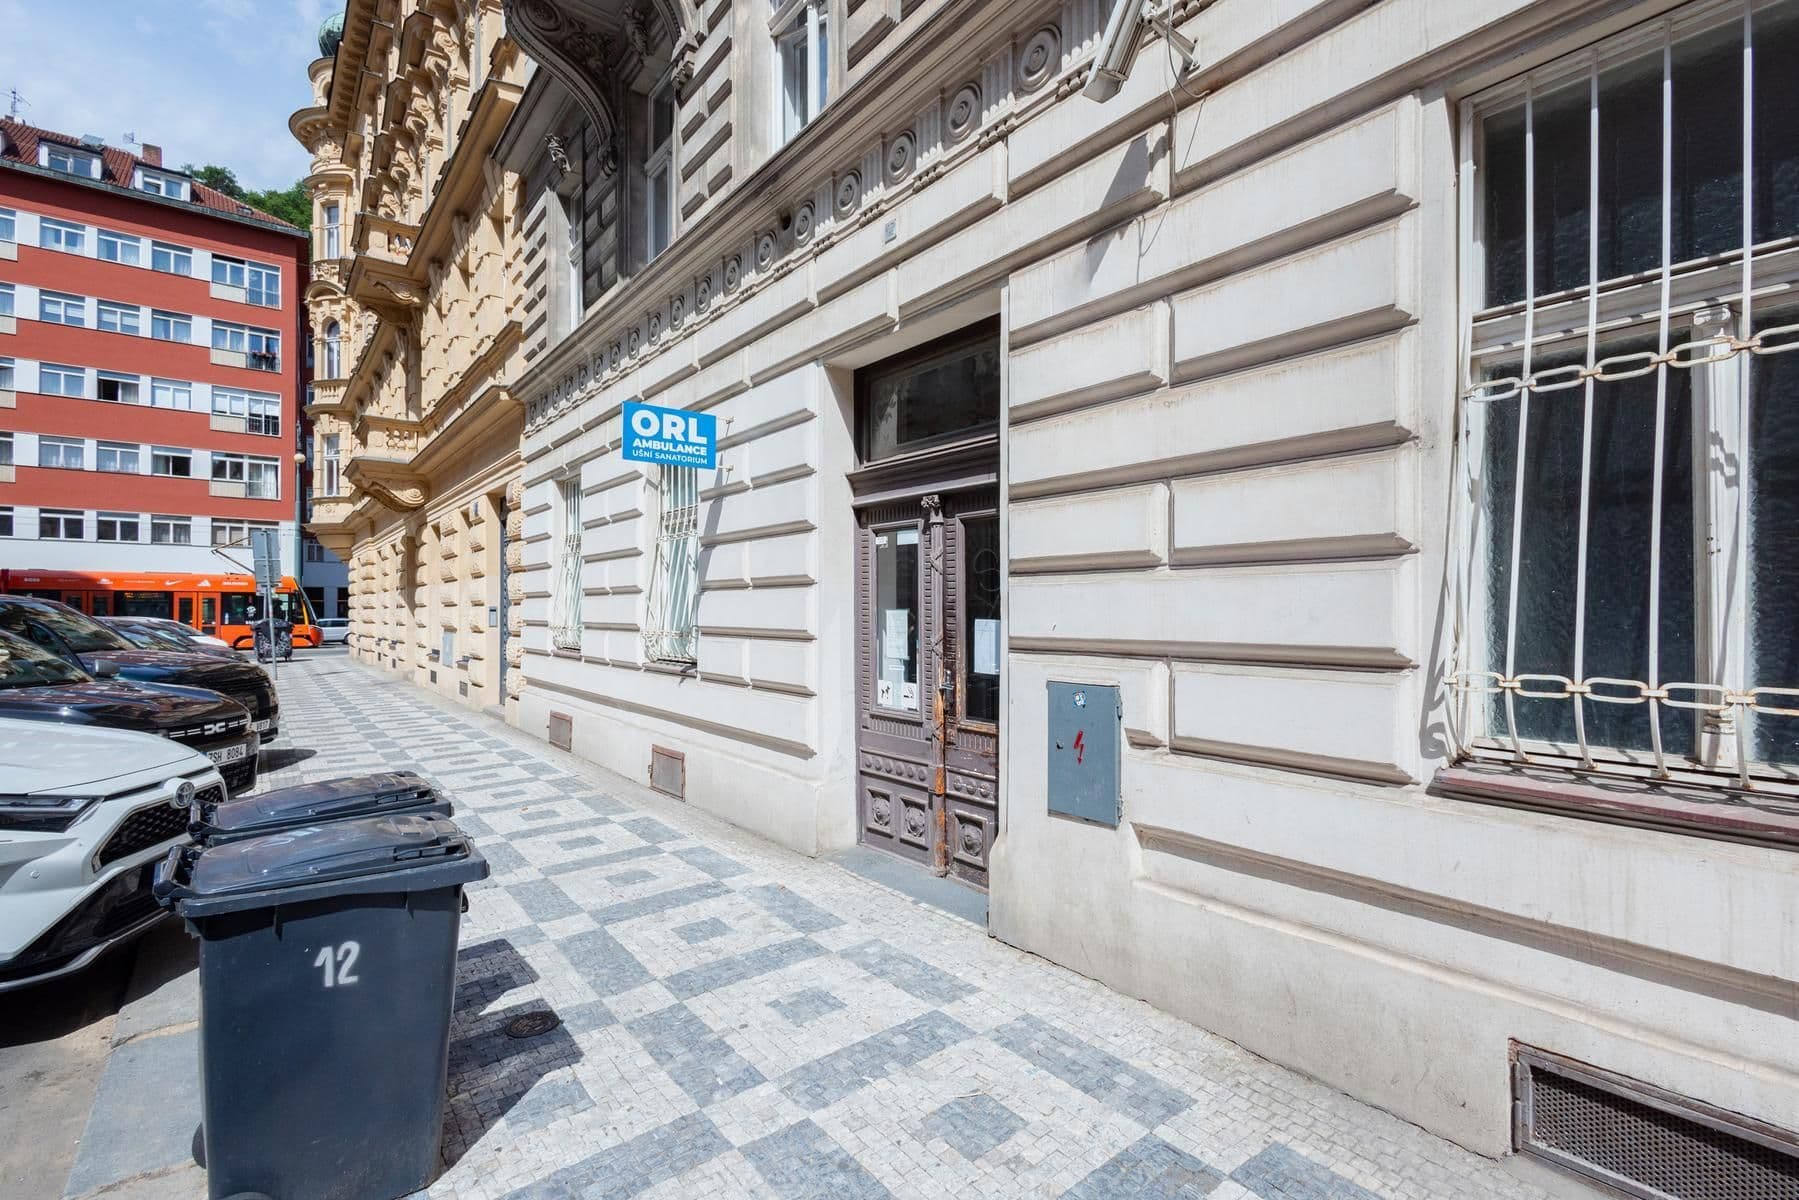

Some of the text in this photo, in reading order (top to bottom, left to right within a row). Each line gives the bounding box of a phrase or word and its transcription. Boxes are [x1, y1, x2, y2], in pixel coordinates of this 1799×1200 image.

[631, 409, 707, 445] ORL
[632, 438, 707, 456] AMBULANCE
[632, 448, 707, 465] UŠNÍ SANATORIUM
[313, 940, 360, 988] 12
